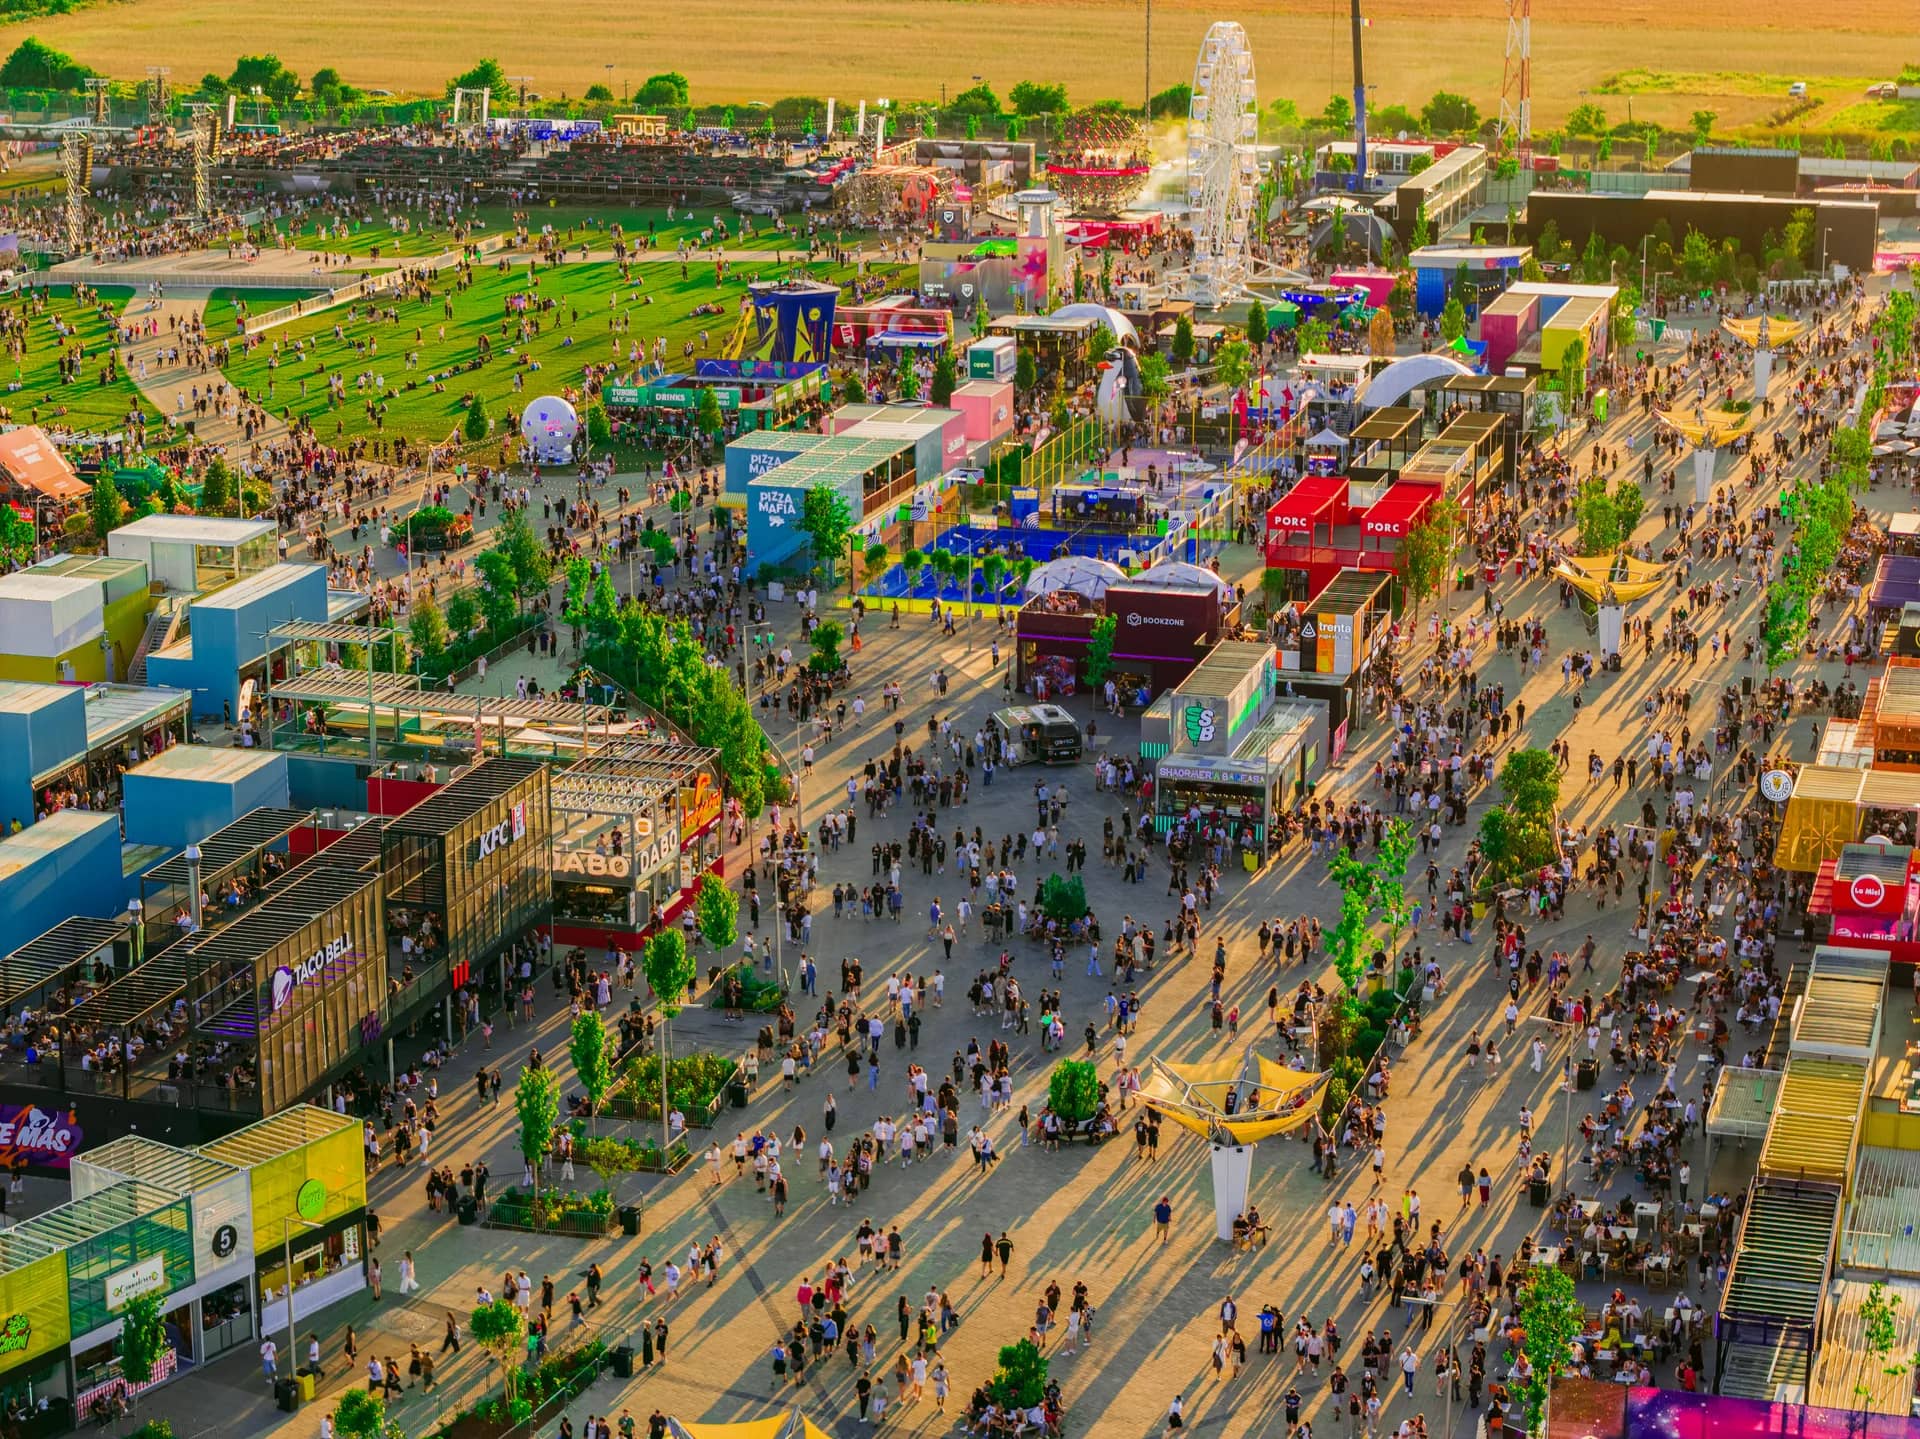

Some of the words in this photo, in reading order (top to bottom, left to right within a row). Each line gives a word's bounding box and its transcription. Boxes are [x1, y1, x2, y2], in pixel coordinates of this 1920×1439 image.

[620, 120, 666, 137] nuba
[655, 393, 686, 402] DRINKS
[750, 454, 782, 466] PIZZA
[749, 463, 775, 475] MAF
[759, 491, 794, 504] PIZZA
[758, 501, 797, 515] MAFIA
[1274, 515, 1307, 527] PORC
[1367, 522, 1400, 533] PORC
[1143, 616, 1185, 626] BOOKZONE
[1318, 621, 1352, 633] trenta
[478, 819, 509, 861] KFC
[640, 829, 678, 874] DABO
[293, 950, 324, 986] TACO
[325, 931, 354, 965] BELL
[220, 1228, 231, 1249] 5
